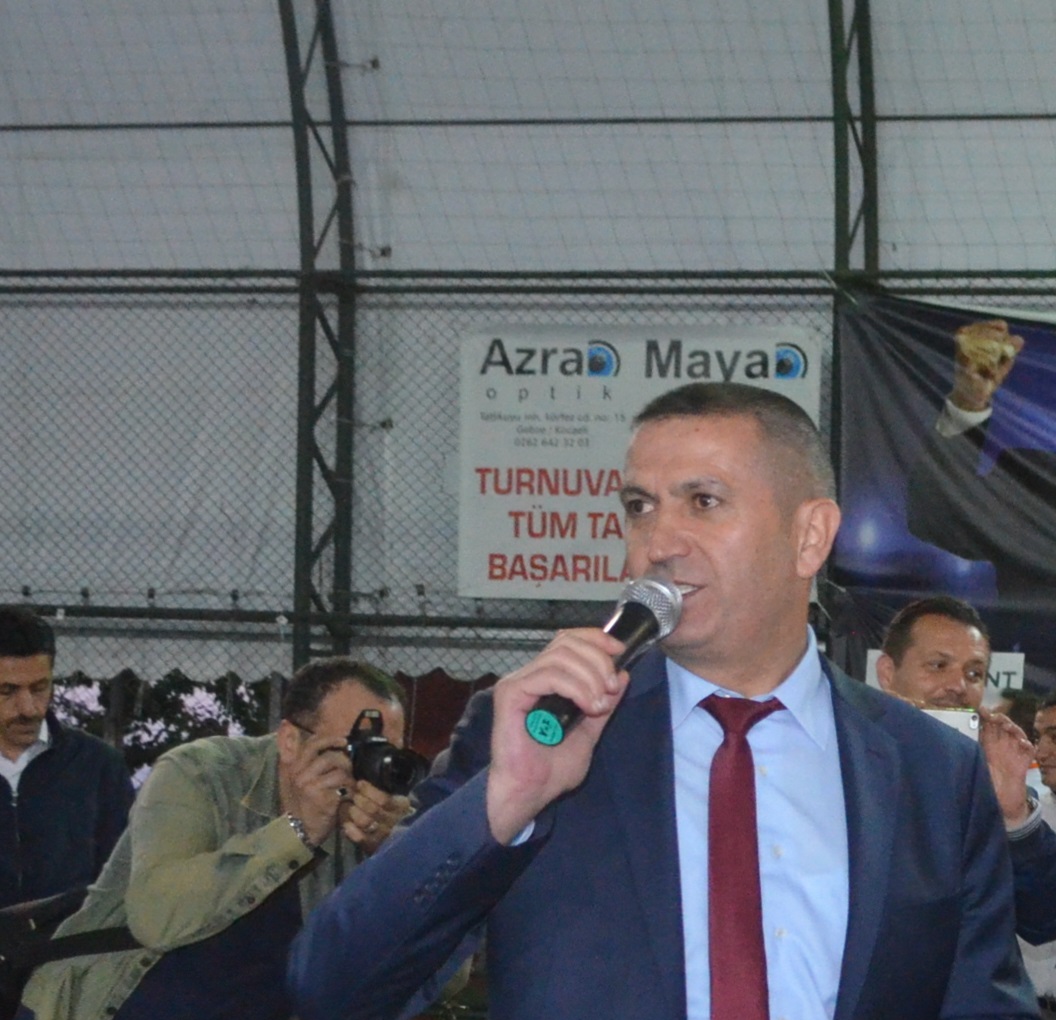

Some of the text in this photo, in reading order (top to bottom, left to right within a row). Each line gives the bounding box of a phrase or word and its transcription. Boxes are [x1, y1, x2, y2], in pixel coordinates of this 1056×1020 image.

[480, 338, 769, 381] Azra Maya
[475, 468, 623, 496] TURNUVA
[508, 503, 623, 539] TÜM TA
